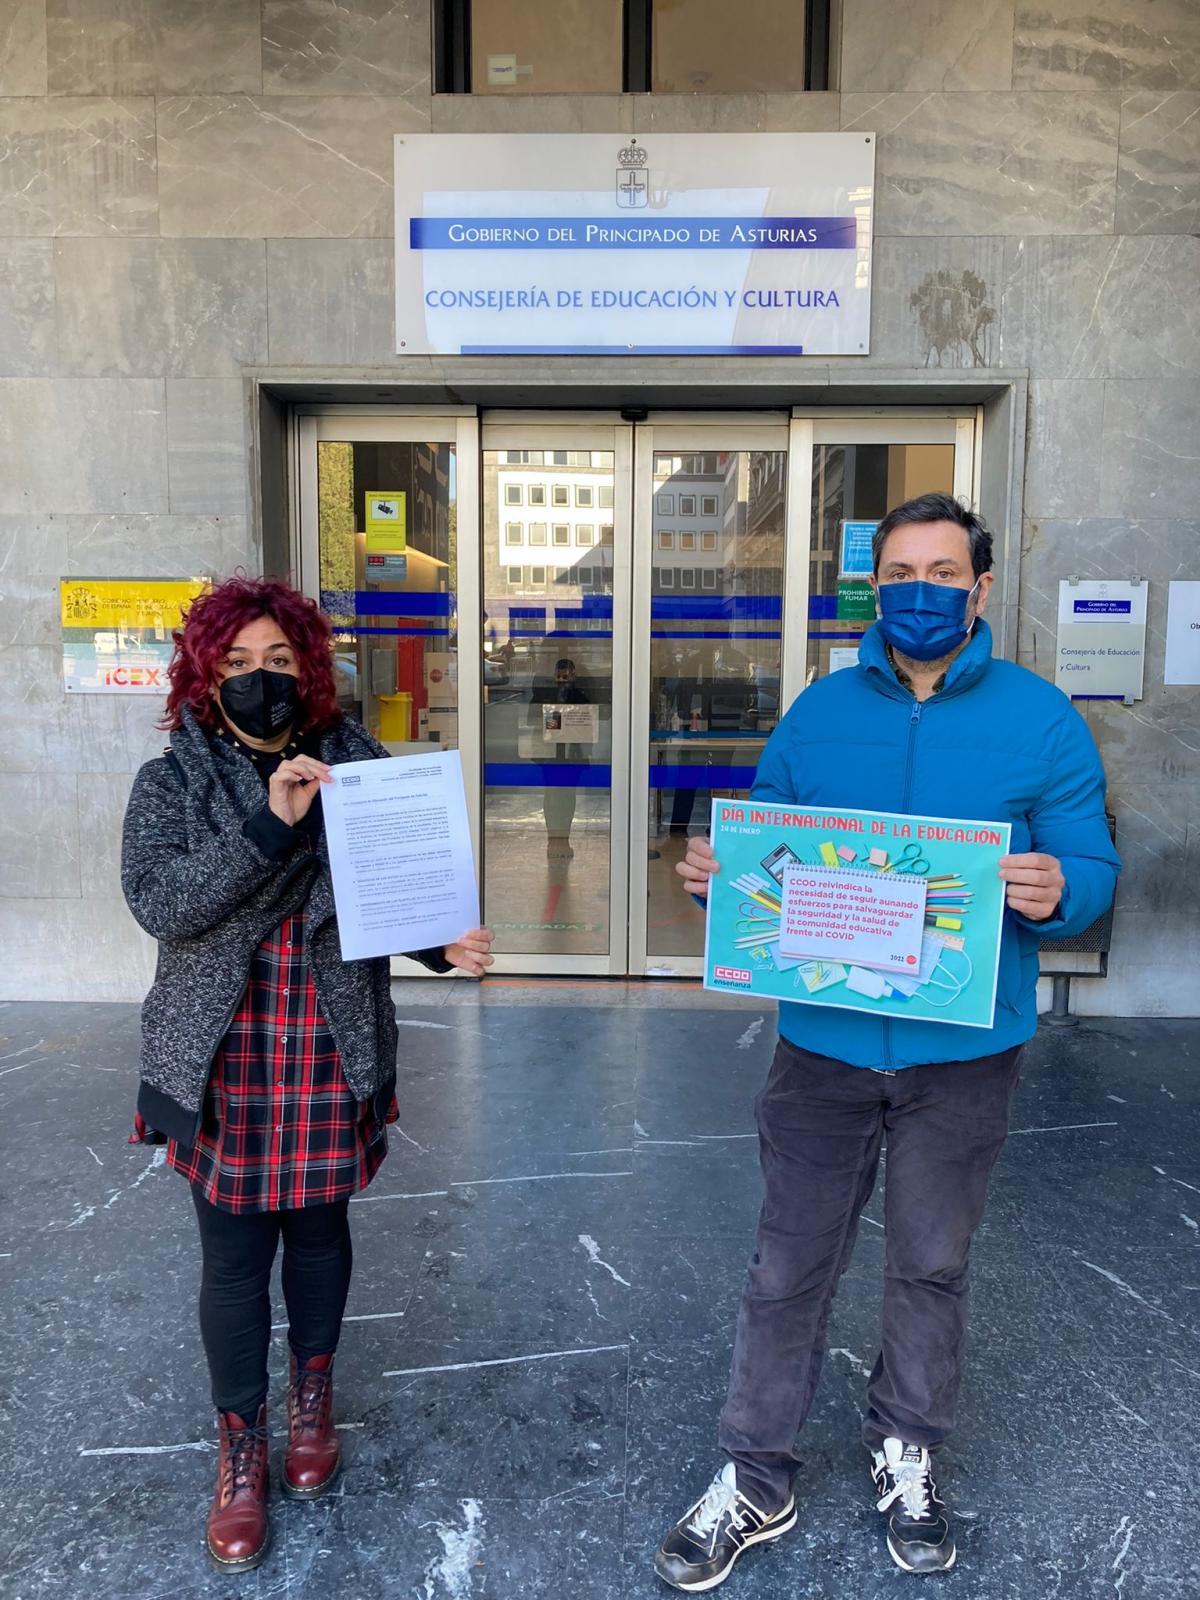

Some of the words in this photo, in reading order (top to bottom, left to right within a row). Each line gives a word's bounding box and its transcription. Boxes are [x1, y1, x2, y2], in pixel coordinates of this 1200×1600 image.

[448, 224, 540, 242] GOBIERNO
[548, 228, 576, 242] DEL
[586, 224, 690, 242] PRINCIPADO
[699, 228, 720, 242] DE
[730, 225, 818, 242] ASTURIAS
[426, 285, 550, 312] CONSEJERÍA
[557, 290, 583, 308] DE
[592, 285, 716, 308] EDUCACIÓN
[724, 290, 736, 308] Y
[743, 290, 840, 308] CULTURA
[1108, 648, 1140, 656] Educación
[722, 804, 745, 822] DÍA
[750, 810, 864, 833] INTERNACIONAL
[871, 820, 887, 835] DE
[893, 823, 911, 838] LA
[918, 824, 1000, 846] EDUCACIÓN
[739, 826, 760, 835] ENERO
[790, 878, 816, 887] CCOO
[818, 880, 862, 892] reivindica
[864, 885, 872, 893] la
[788, 888, 834, 899] necesidad
[836, 891, 848, 900] de
[850, 894, 876, 904] seguir
[879, 898, 919, 910] aunando
[788, 898, 831, 908] esfuerzos
[832, 902, 853, 911] para
[855, 904, 914, 919] salvaguardar
[787, 917, 795, 925] la
[796, 919, 847, 930] comunidad
[848, 924, 892, 936] educativa
[798, 909, 842, 920] seguridad
[862, 914, 886, 926] salud
[888, 919, 900, 928] de
[786, 927, 813, 936] frente
[825, 931, 854, 941] COVID
[716, 968, 750, 980] CCOO
[714, 980, 751, 989] enseñanza
